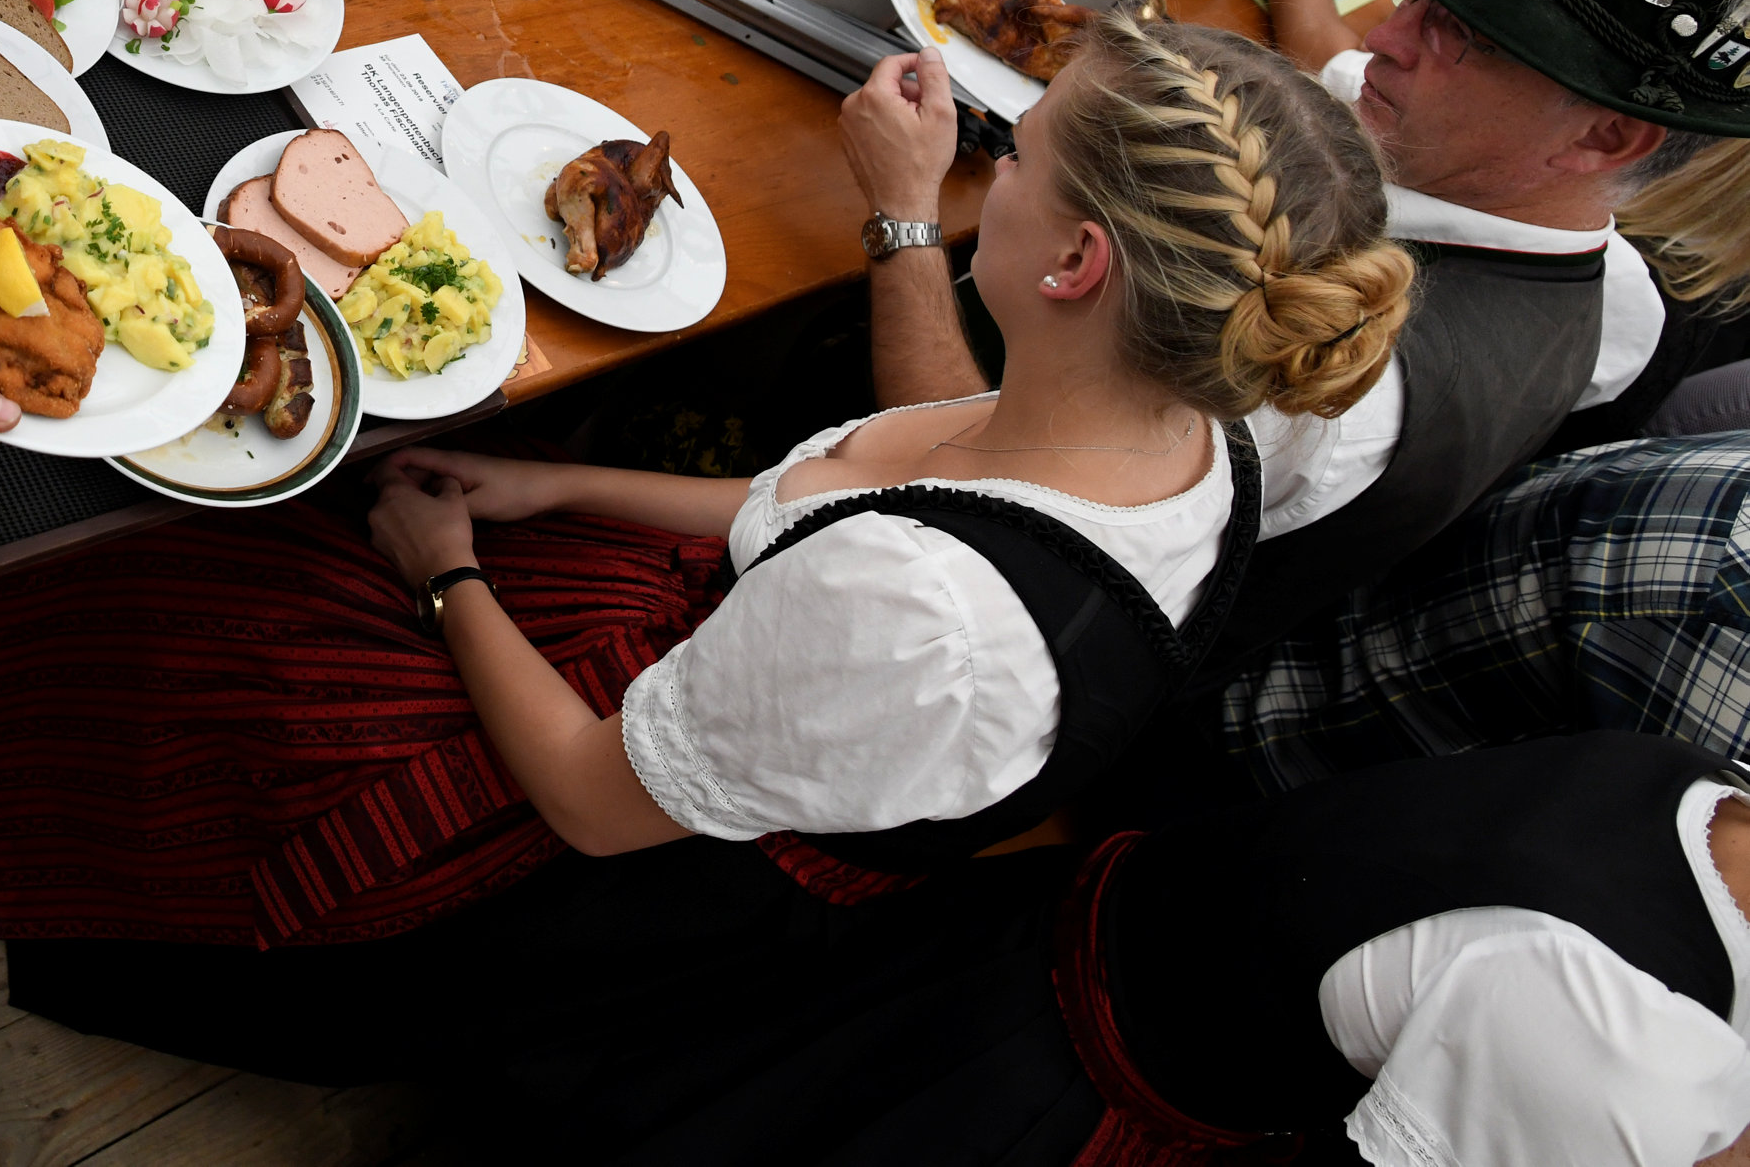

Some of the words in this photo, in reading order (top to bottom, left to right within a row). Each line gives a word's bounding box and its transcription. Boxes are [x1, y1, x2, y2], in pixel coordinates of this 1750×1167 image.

[385, 62, 407, 88] Personen
[361, 71, 390, 107] Thomas
[390, 109, 431, 161] Fischhaber
[364, 63, 379, 78] BK
[377, 79, 444, 164] Langenpettenbach
[377, 108, 385, 116] La
[383, 116, 397, 133] Carte
